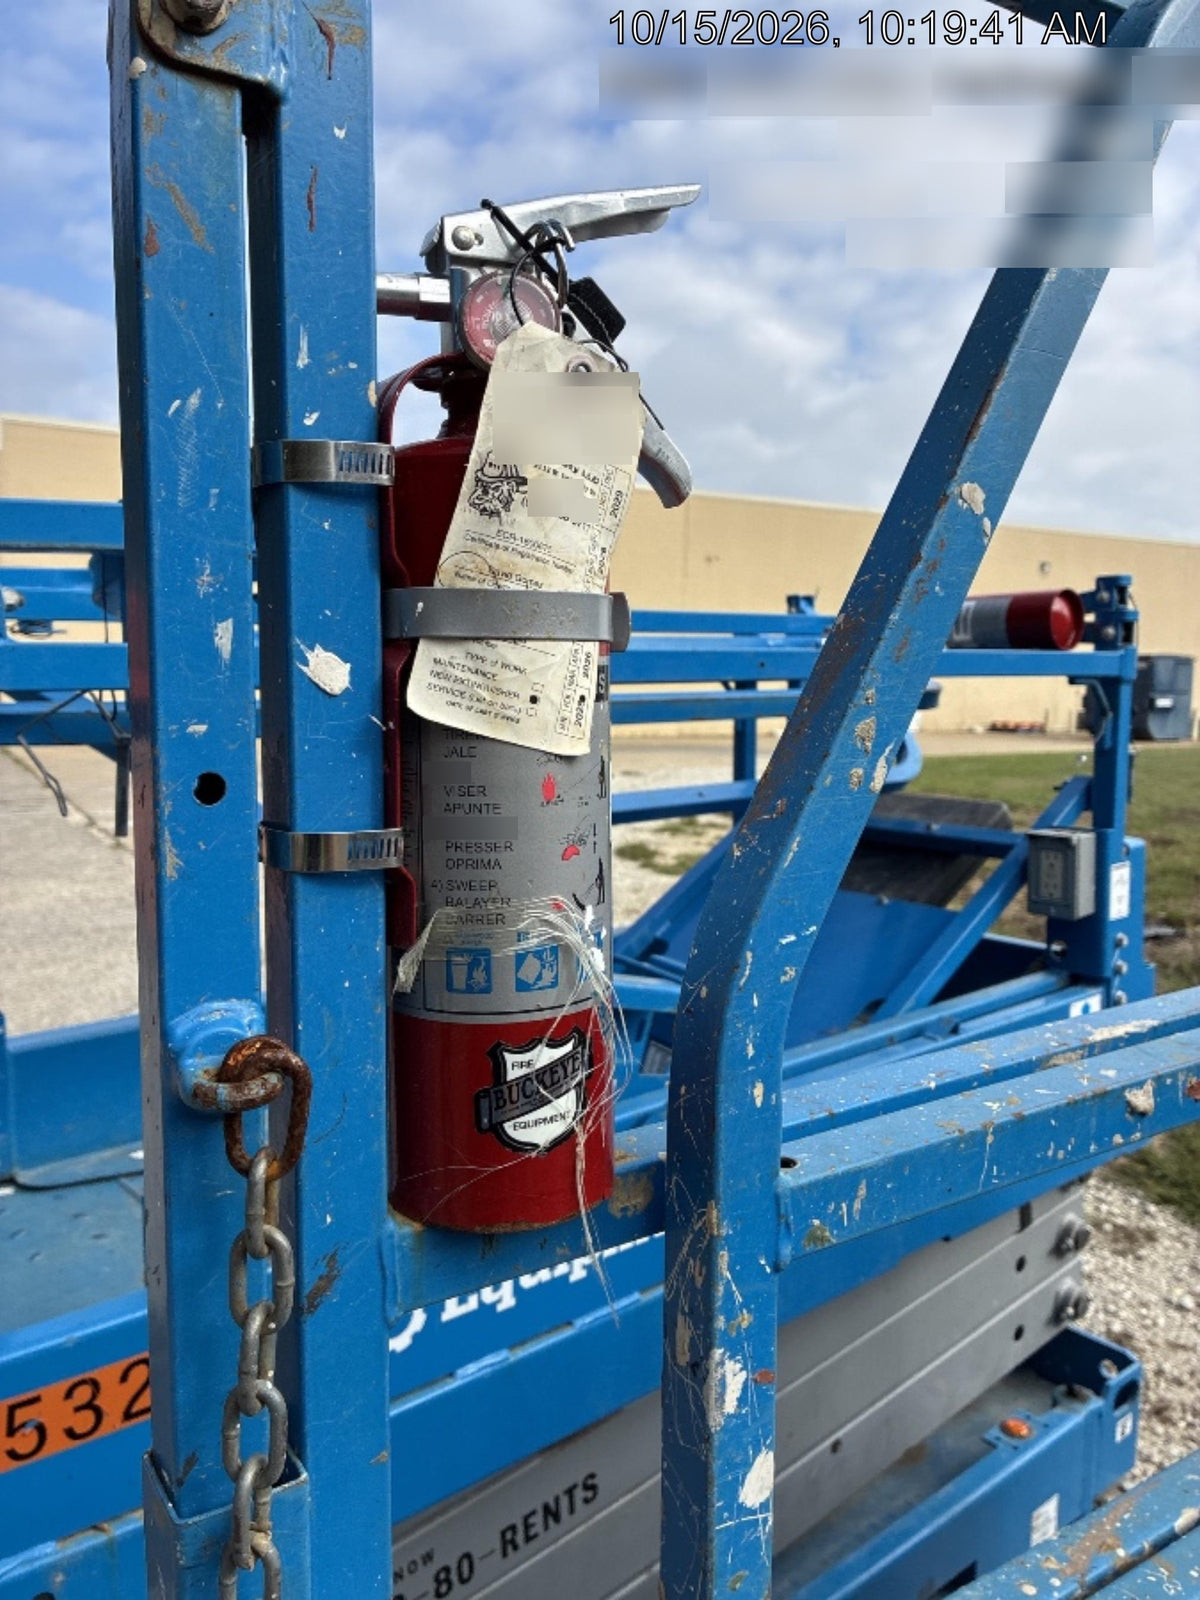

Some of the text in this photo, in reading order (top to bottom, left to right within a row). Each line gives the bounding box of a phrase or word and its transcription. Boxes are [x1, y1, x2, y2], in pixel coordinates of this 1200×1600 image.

[609, 490, 623, 519] 2029
[441, 745, 478, 759] JALE
[444, 785, 488, 798] VISER
[444, 803, 501, 816] APUNTE
[445, 841, 514, 853] PRESSER
[445, 858, 502, 871] OPRIMA
[446, 879, 499, 892] SWEEP
[445, 896, 513, 909] BALAYER
[511, 1059, 535, 1071] FIRE
[493, 1052, 583, 1112] BUCKEYE
[513, 1110, 571, 1131] EQUIPMENT
[5, 1356, 152, 1462] 532
